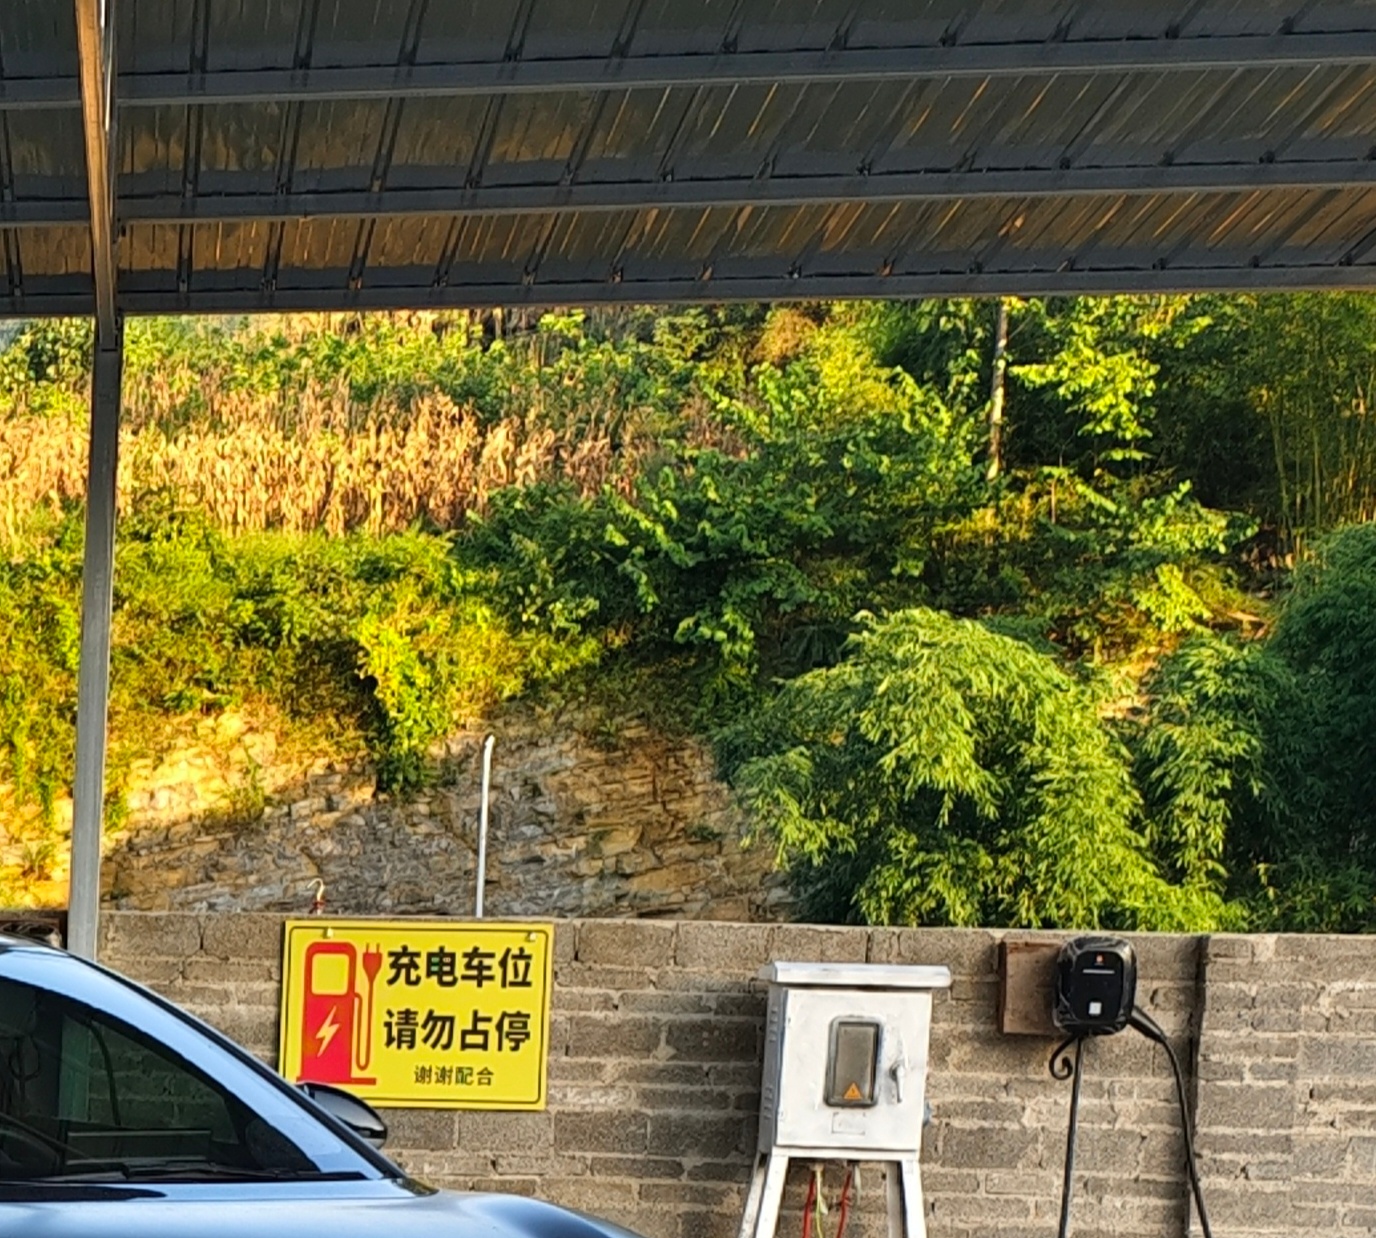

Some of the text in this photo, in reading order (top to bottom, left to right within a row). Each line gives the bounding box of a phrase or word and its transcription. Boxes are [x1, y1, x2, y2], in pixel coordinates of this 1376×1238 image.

[386, 945, 533, 988] 充电车位
[383, 1008, 531, 1052] 请勿占停
[414, 1065, 494, 1086] 谢谢配合
